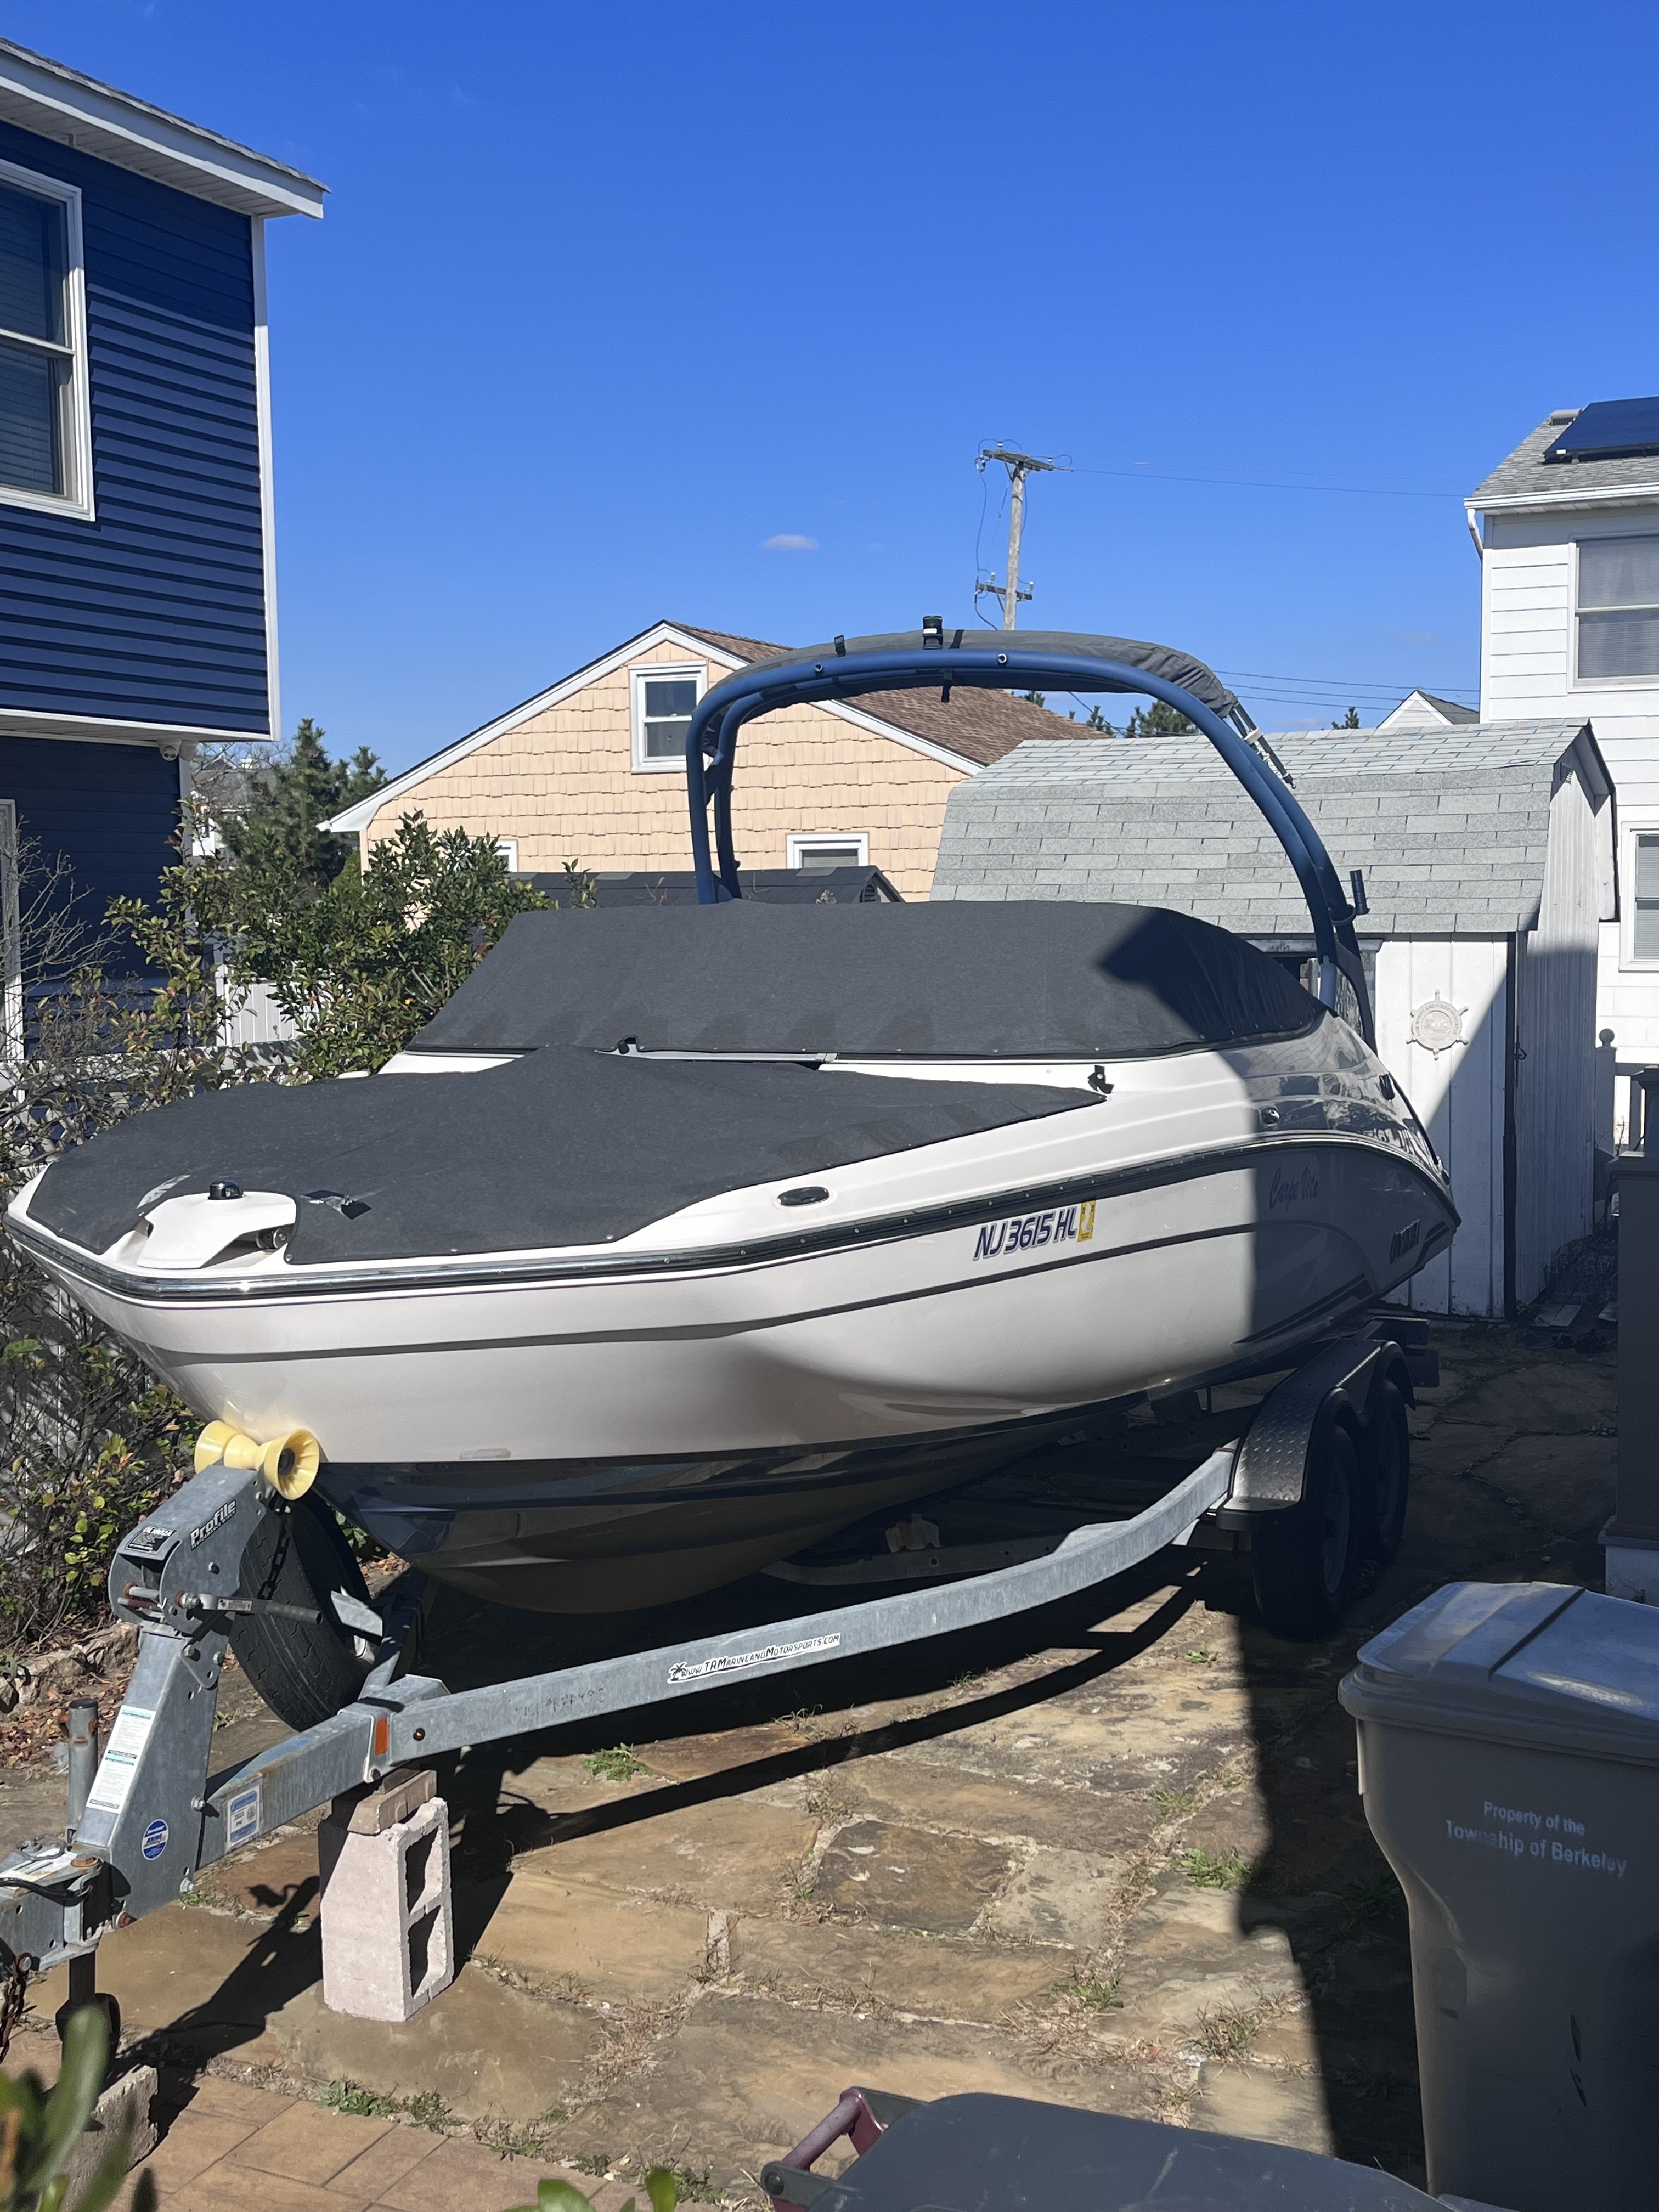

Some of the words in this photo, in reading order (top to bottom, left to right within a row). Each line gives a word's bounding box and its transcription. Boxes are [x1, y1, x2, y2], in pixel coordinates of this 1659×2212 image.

[973, 1221, 1008, 1261] NJ
[1003, 1211, 1056, 1255] 3615
[1053, 1206, 1077, 1243] HL
[190, 1500, 236, 1545] Profile
[1483, 1801, 1542, 1829] Property
[1545, 1815, 1561, 1830] of
[1563, 1817, 1585, 1835] the
[1445, 1819, 1524, 1857] Township
[1530, 1839, 1547, 1858] of
[1551, 1841, 1627, 1878] Berkeley
